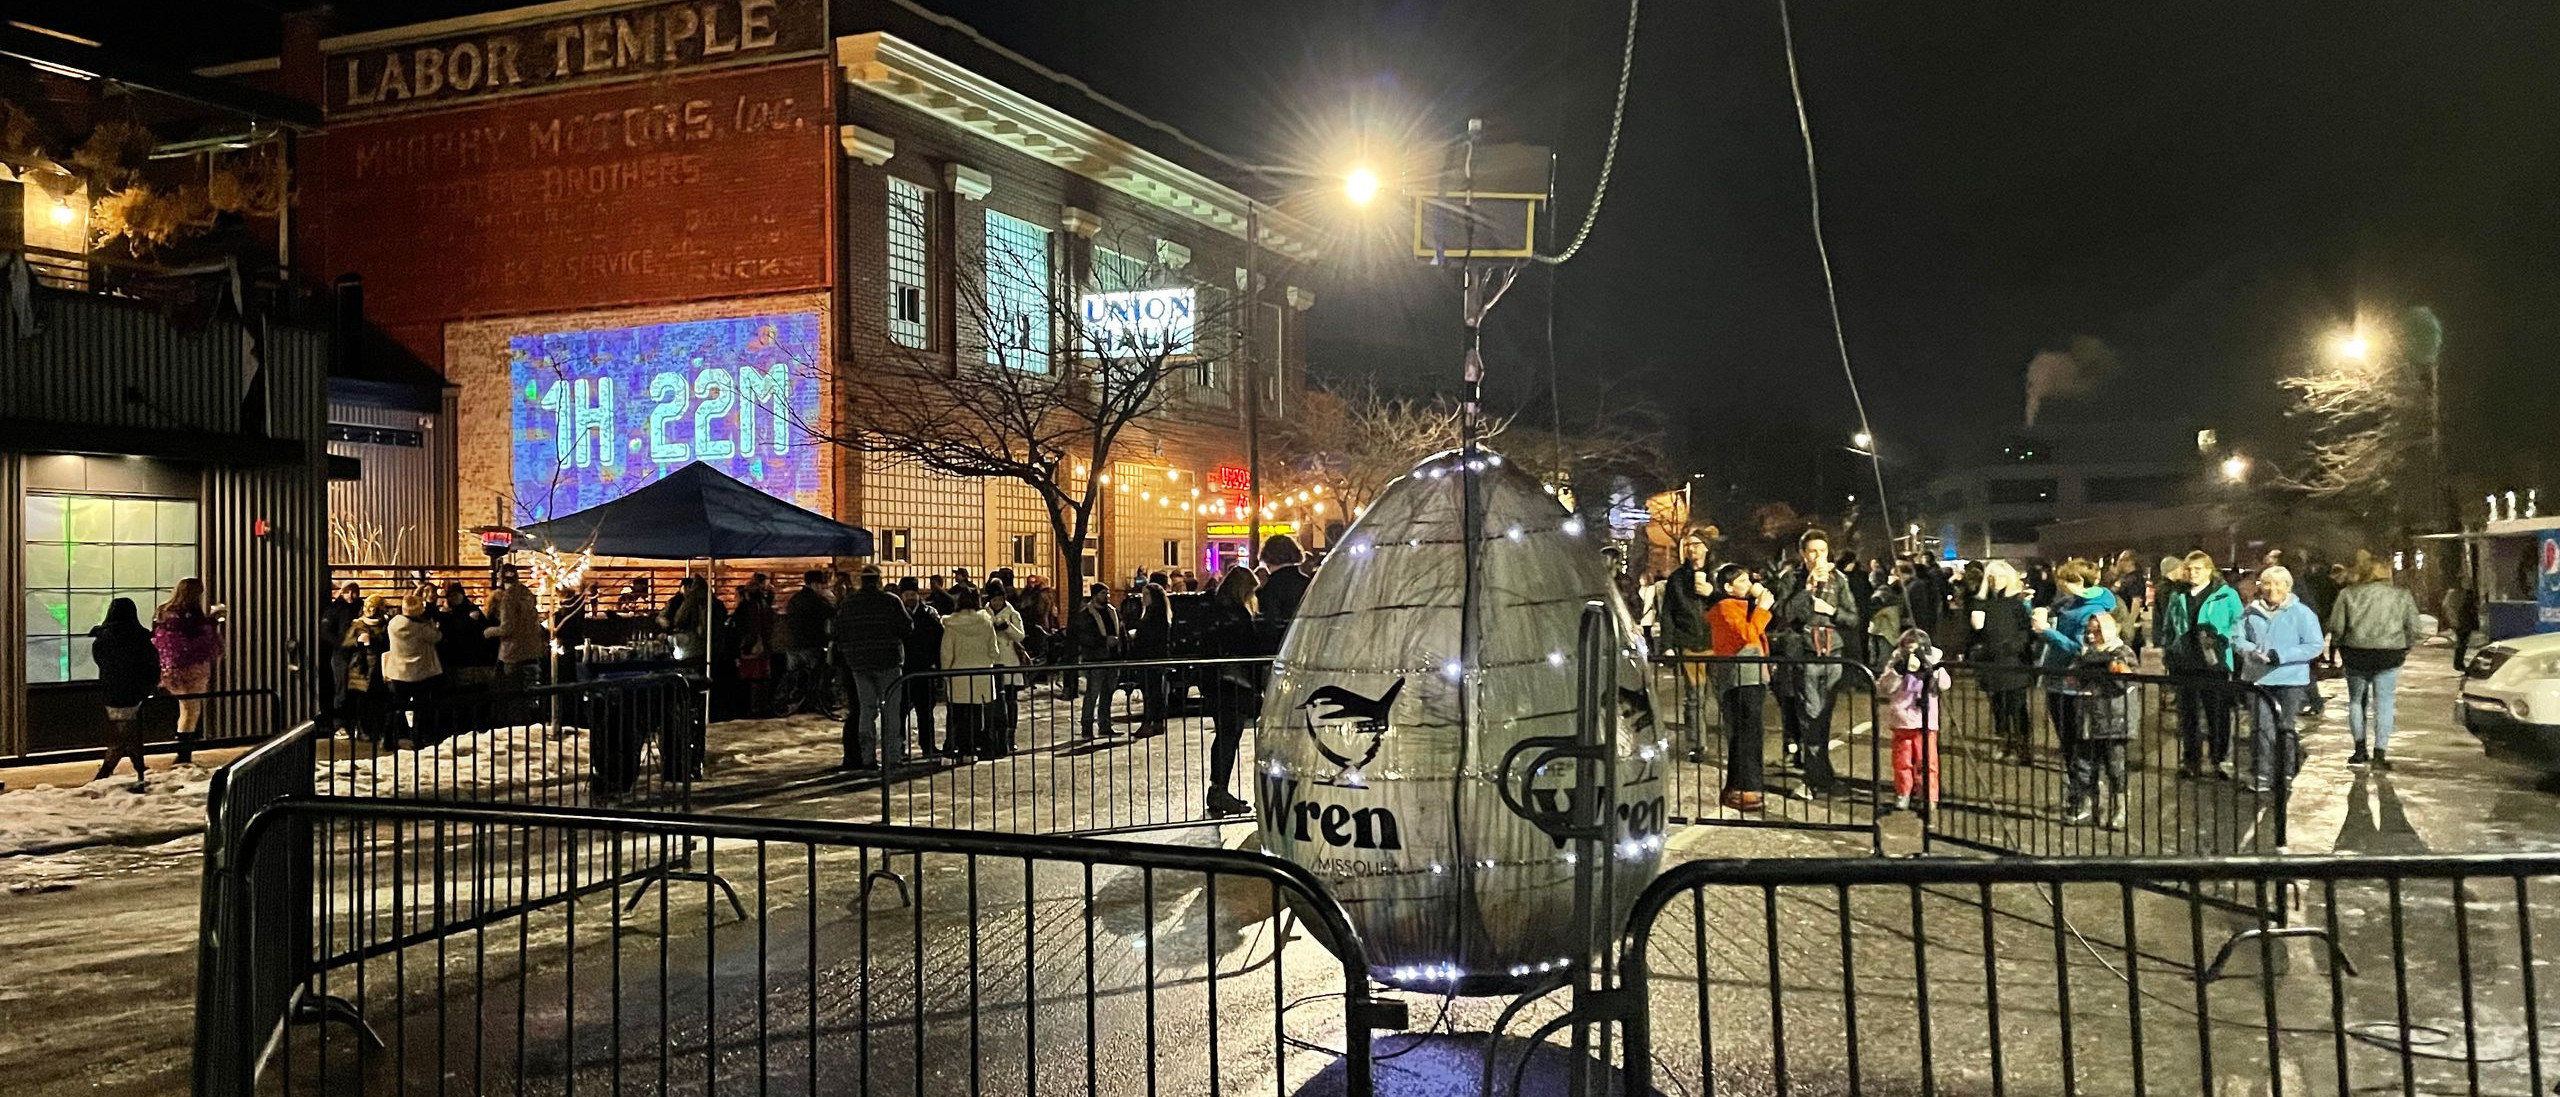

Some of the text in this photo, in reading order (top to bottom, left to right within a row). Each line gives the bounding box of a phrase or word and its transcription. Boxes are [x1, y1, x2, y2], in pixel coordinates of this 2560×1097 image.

[346, 0, 779, 107] LABOR TEMPLE
[355, 125, 507, 180] MURPHY
[1086, 294, 1190, 323] UNION
[540, 363, 790, 470] 1H 22M
[1259, 772, 1402, 850] Wren
